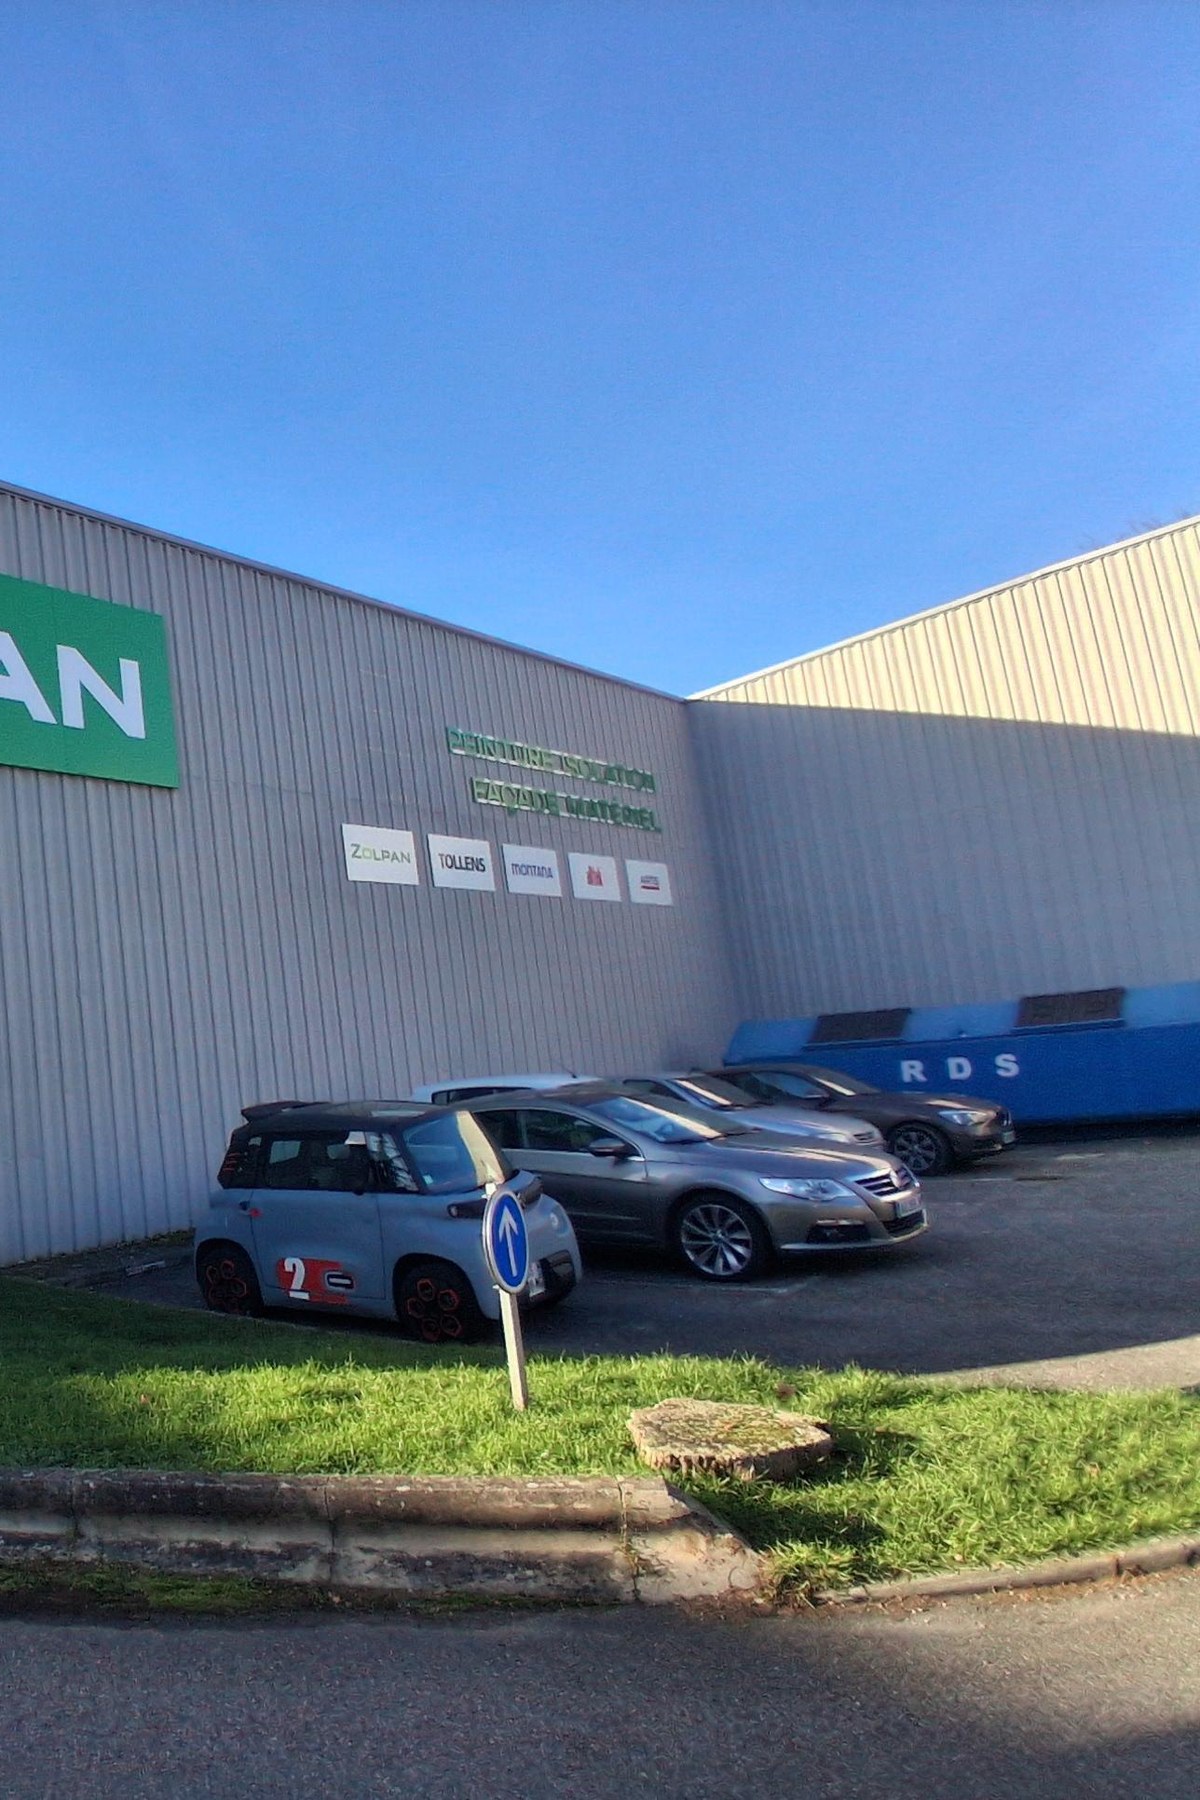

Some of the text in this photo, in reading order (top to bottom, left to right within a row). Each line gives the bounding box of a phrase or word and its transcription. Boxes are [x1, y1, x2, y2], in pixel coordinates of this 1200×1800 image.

[446, 727, 554, 773] PEINTURE
[350, 843, 411, 864] ZOLPAN
[438, 853, 486, 873] TOLLENS
